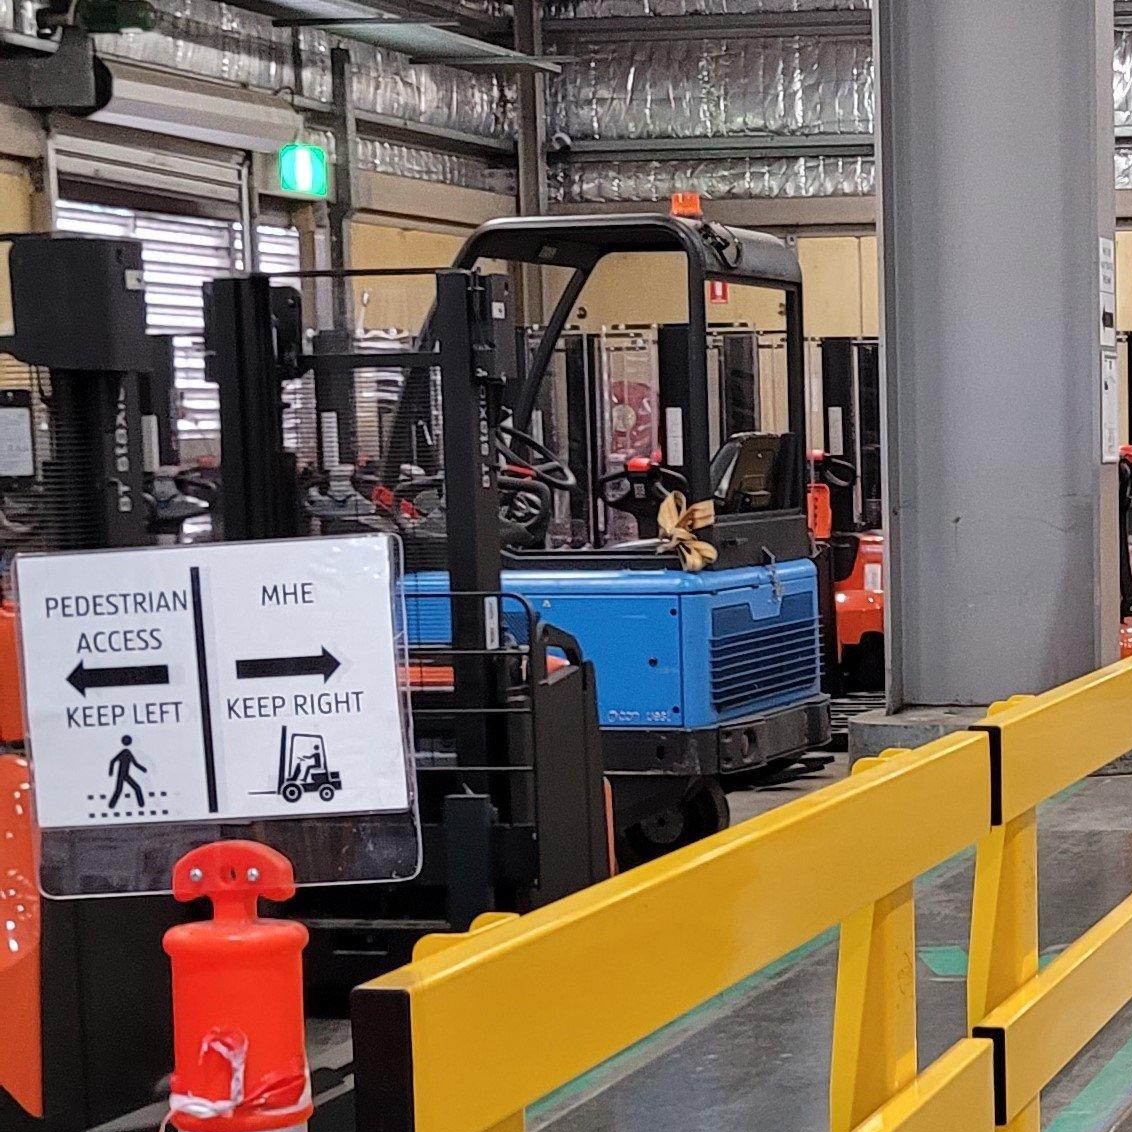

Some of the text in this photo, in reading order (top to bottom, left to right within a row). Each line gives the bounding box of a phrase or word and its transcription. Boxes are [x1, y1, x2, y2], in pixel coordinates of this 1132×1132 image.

[45, 590, 188, 618] PEDESTRIAN
[261, 582, 314, 606] MHE
[76, 628, 163, 654] ACCESS
[66, 701, 183, 728] KEEP LEFT
[226, 690, 364, 719] KEEP RIGHT
